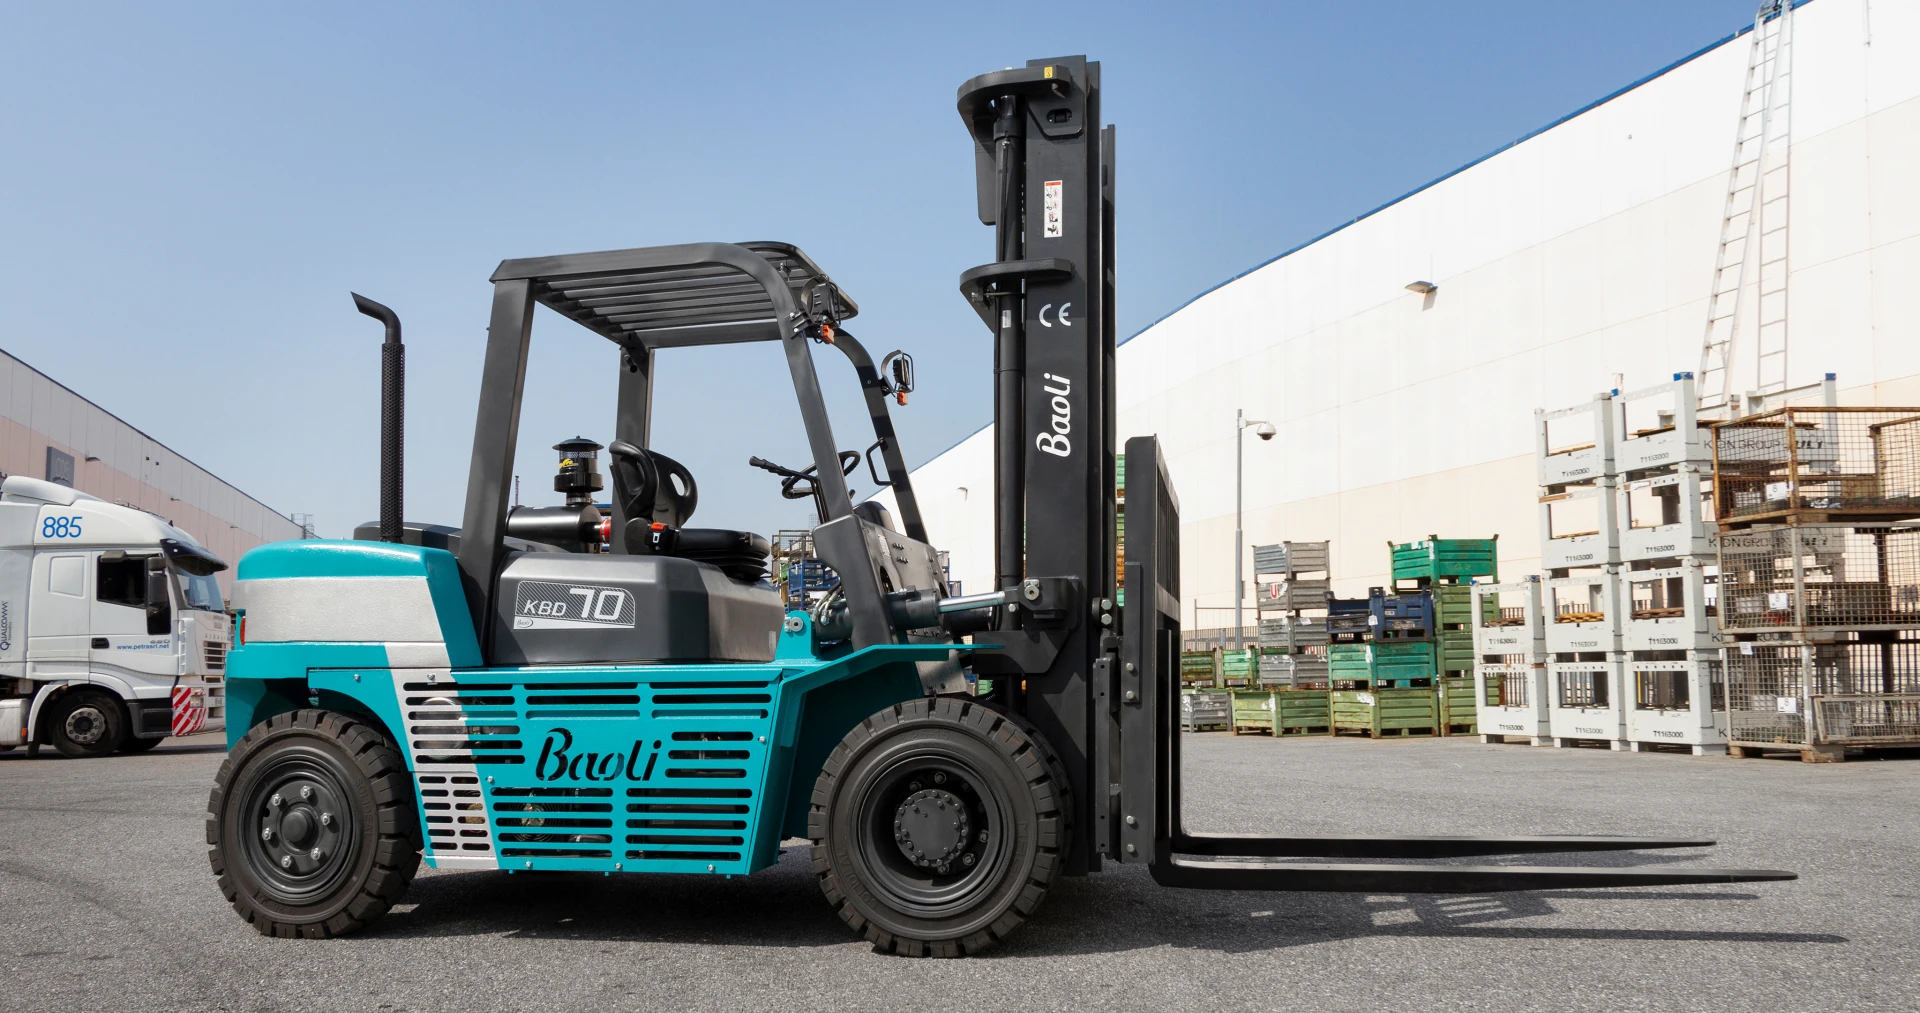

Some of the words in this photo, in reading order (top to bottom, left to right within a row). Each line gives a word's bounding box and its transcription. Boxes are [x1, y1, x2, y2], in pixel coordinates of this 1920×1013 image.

[1039, 302, 1071, 328] CE
[1036, 373, 1071, 457] Baoli
[1704, 440, 1736, 449] KON
[1739, 440, 1780, 449] GROUP
[42, 516, 82, 538] 885
[1709, 538, 1741, 548] KON
[524, 600, 566, 616] KBD
[570, 588, 625, 620] 70
[0, 601, 11, 650] QUALCOMM
[117, 643, 170, 651] www.petrasrl.net
[535, 727, 663, 782] Baoli
